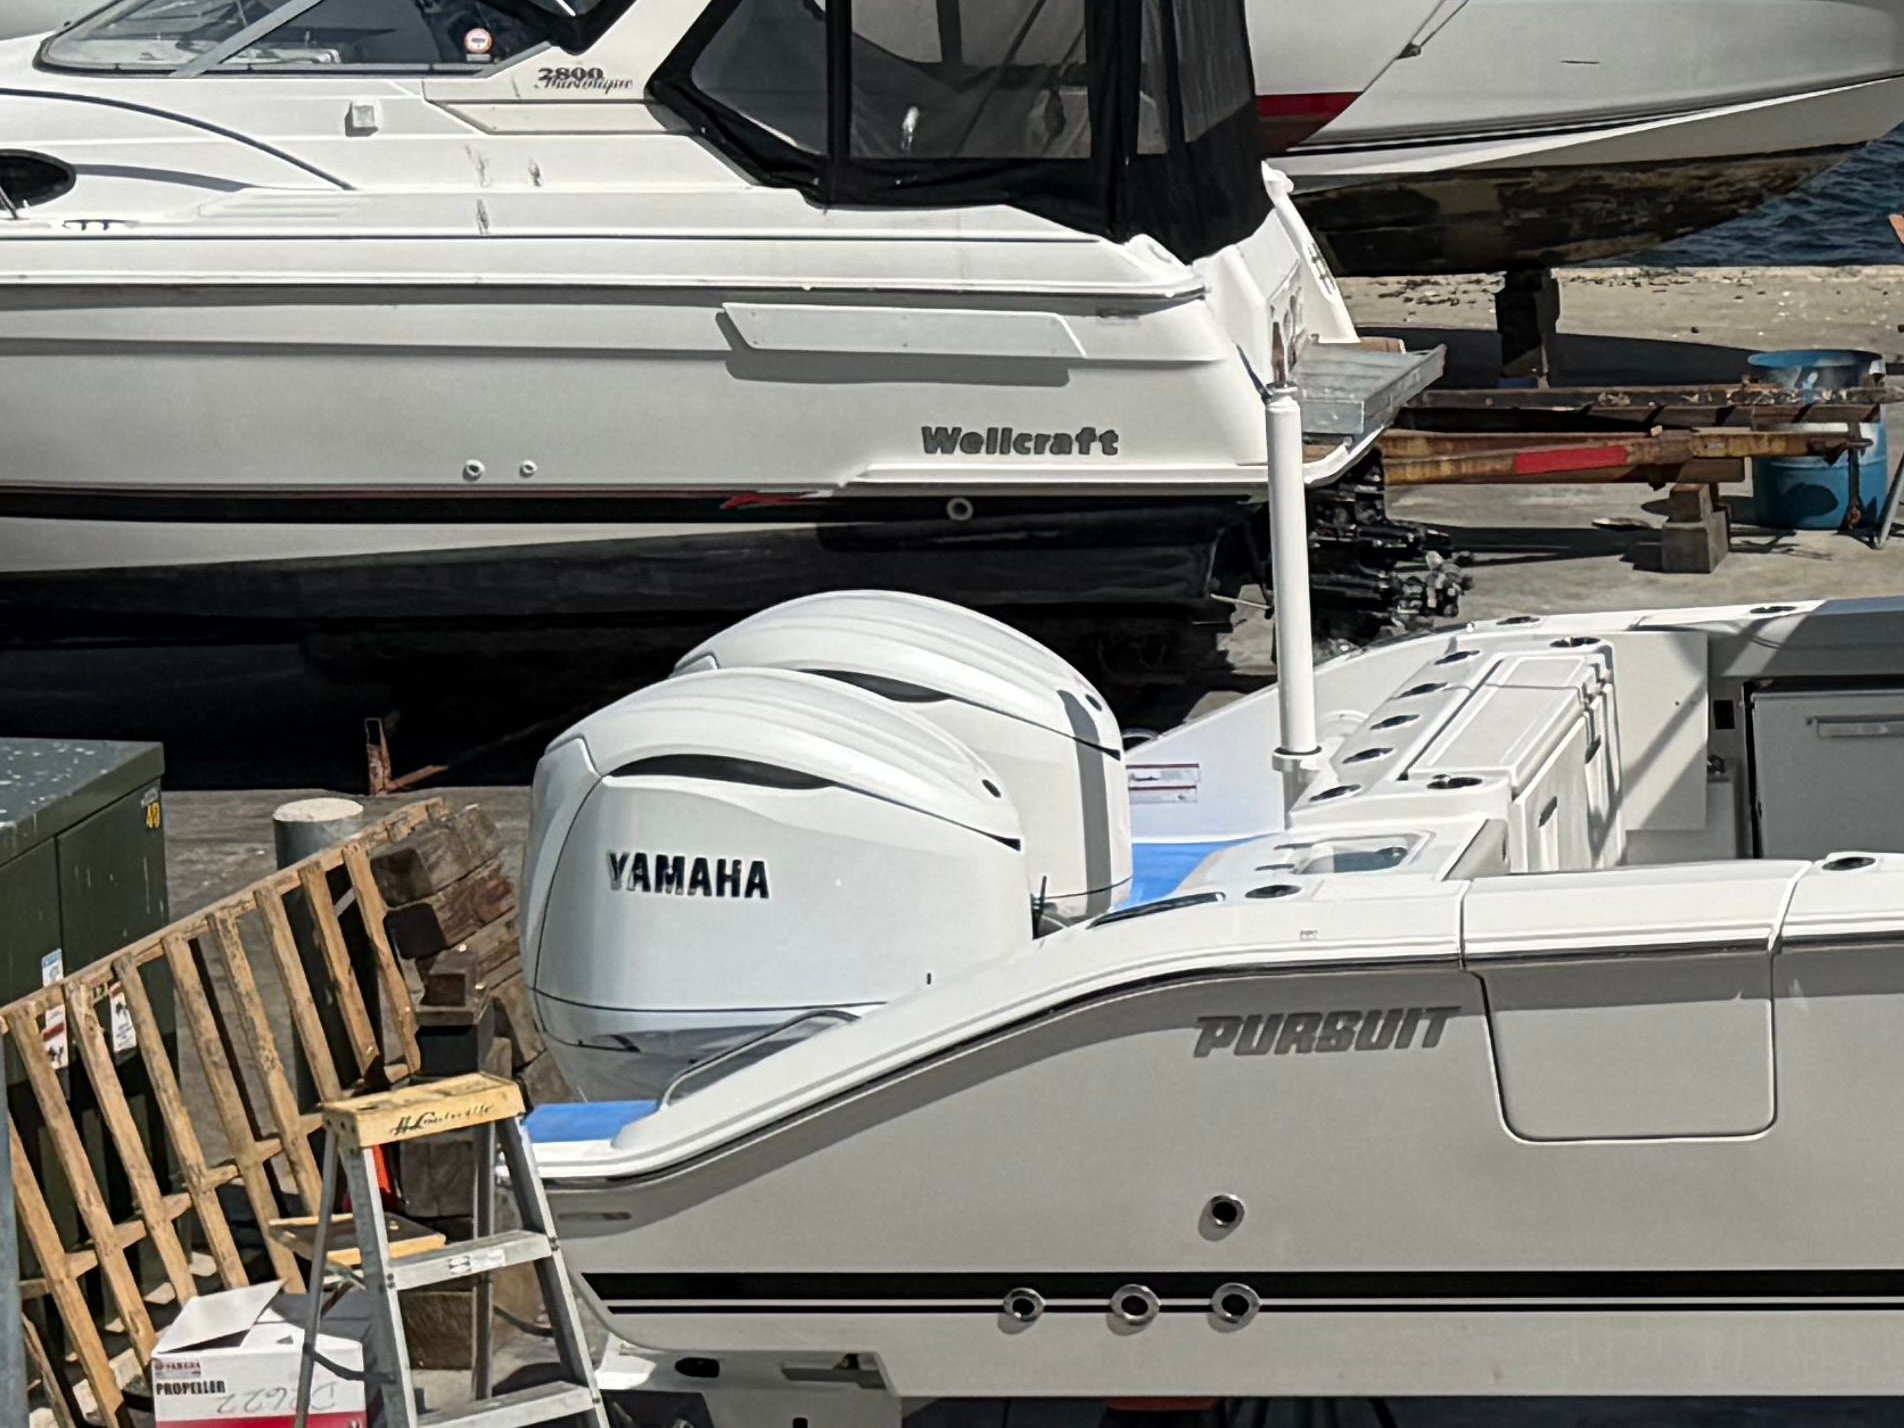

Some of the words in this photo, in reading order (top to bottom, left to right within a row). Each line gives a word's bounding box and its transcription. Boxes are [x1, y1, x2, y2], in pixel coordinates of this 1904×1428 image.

[537, 67, 604, 82] 2800
[921, 426, 1120, 456] Wellcraft
[606, 851, 770, 899] YAMAHA
[1193, 1005, 1463, 1058] PURSUIT
[156, 1380, 226, 1396] PROPELLER
